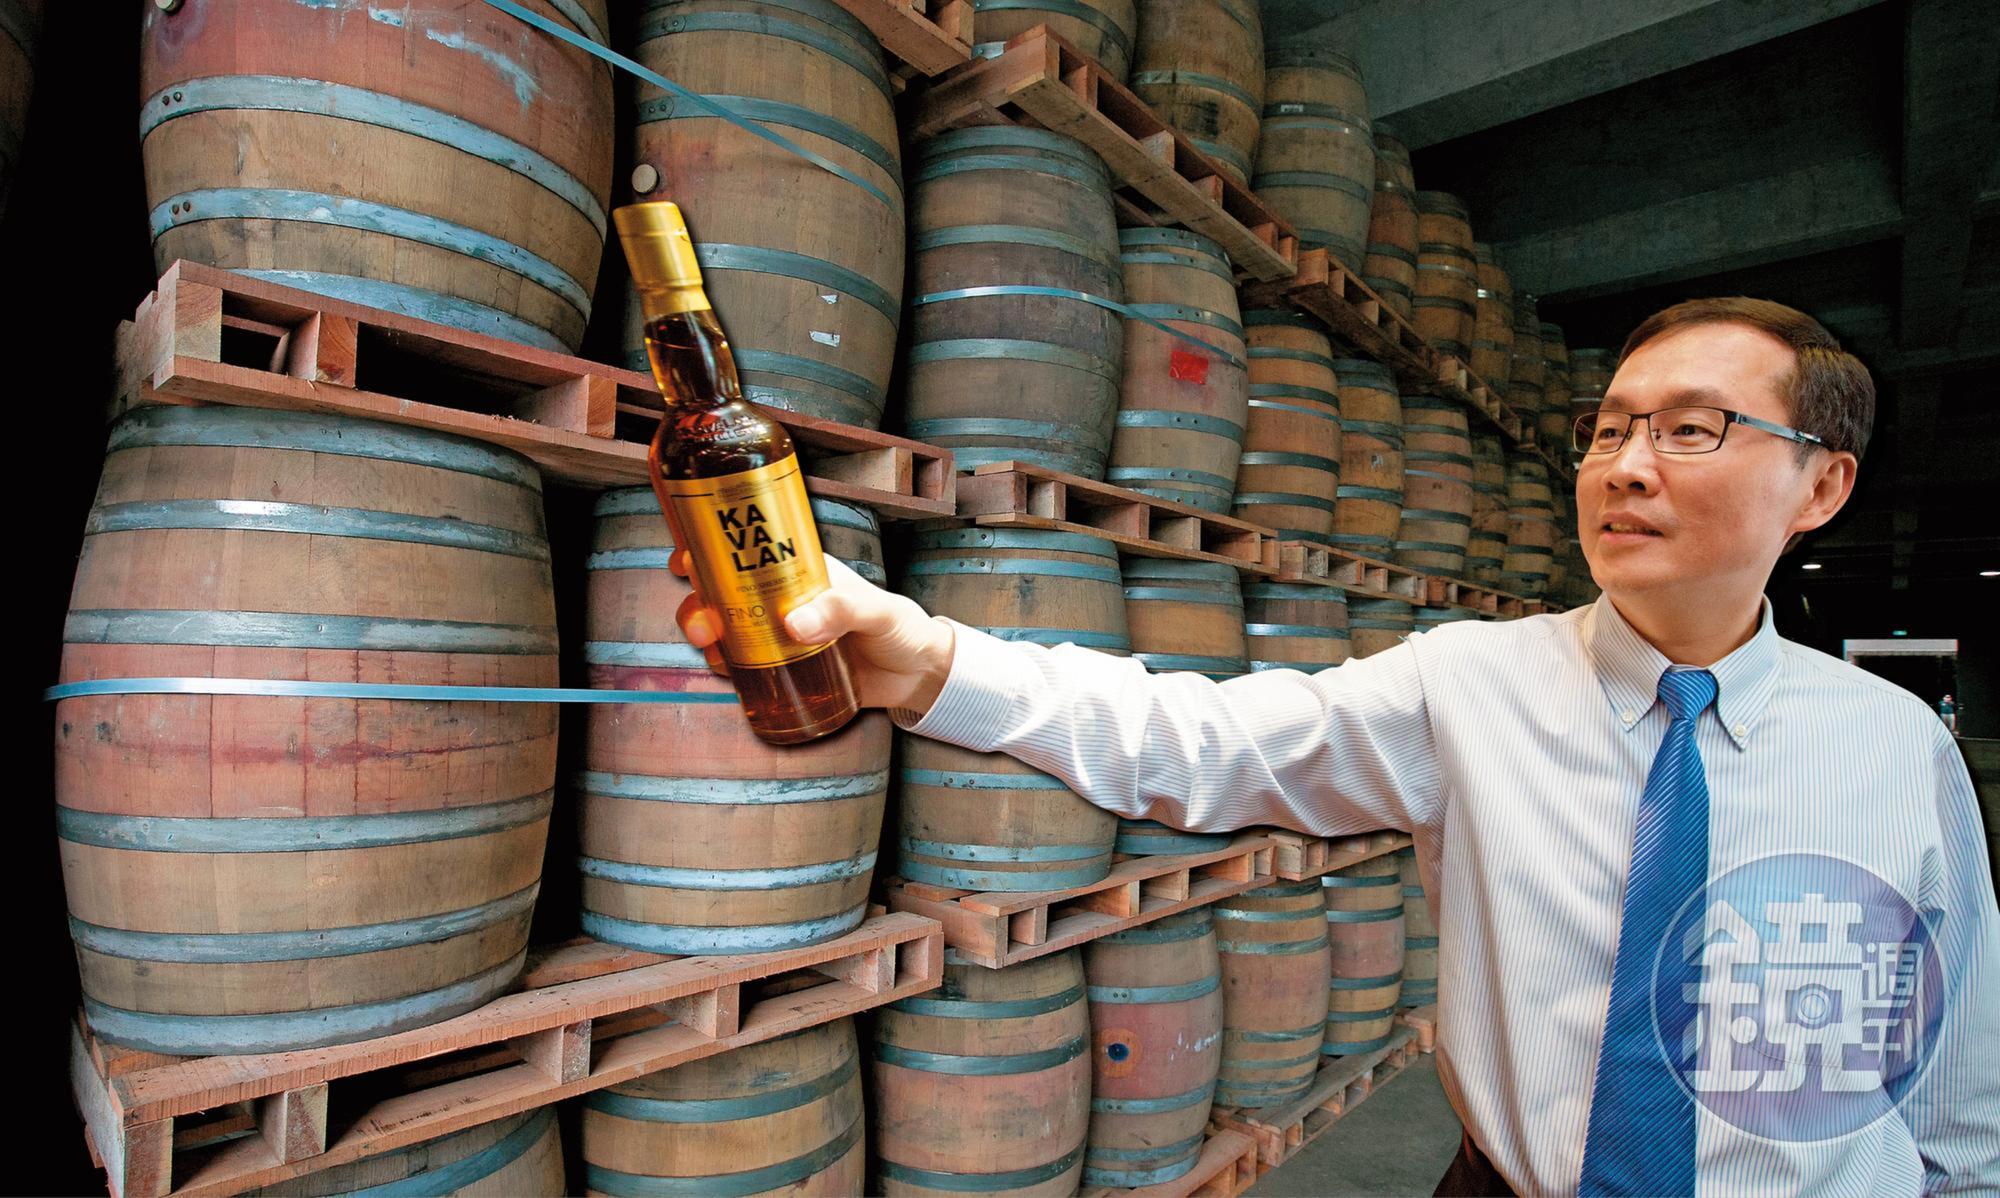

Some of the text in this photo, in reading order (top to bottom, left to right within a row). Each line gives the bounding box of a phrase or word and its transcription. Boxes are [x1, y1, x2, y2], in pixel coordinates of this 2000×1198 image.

[717, 504, 767, 531] KA
[724, 525, 773, 550] VA
[731, 538, 797, 572] LAN
[726, 604, 766, 623] FINO
